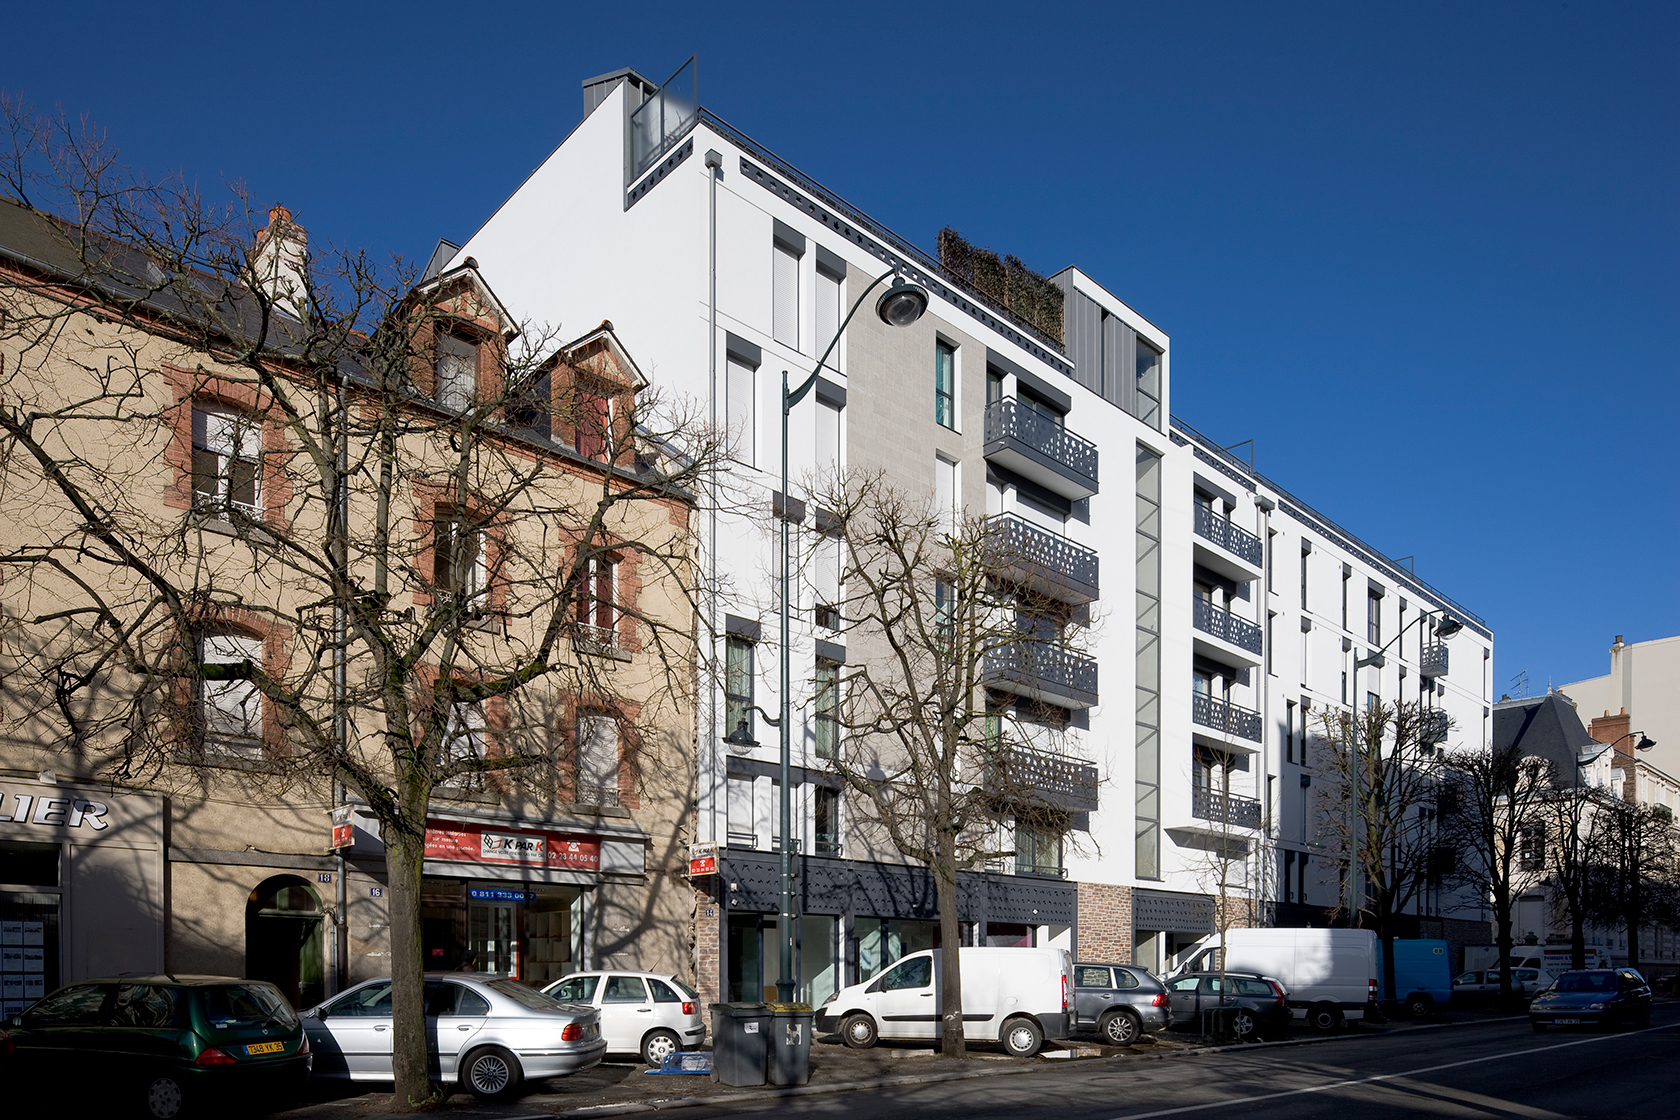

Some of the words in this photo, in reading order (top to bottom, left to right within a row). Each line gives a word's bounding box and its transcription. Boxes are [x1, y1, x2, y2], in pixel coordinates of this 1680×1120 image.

[503, 839, 514, 850] K
[514, 841, 534, 852] PAR
[535, 841, 545, 852] K
[547, 851, 557, 860] 02
[558, 852, 567, 860] 23
[568, 853, 578, 861] 44
[579, 854, 588, 863] 05
[589, 855, 599, 863] 40
[320, 873, 330, 882] 18
[372, 888, 381, 897] 16
[479, 890, 495, 898] 811
[497, 891, 513, 899] 333
[247, 1044, 264, 1054] 7348
[265, 1043, 275, 1052] YK
